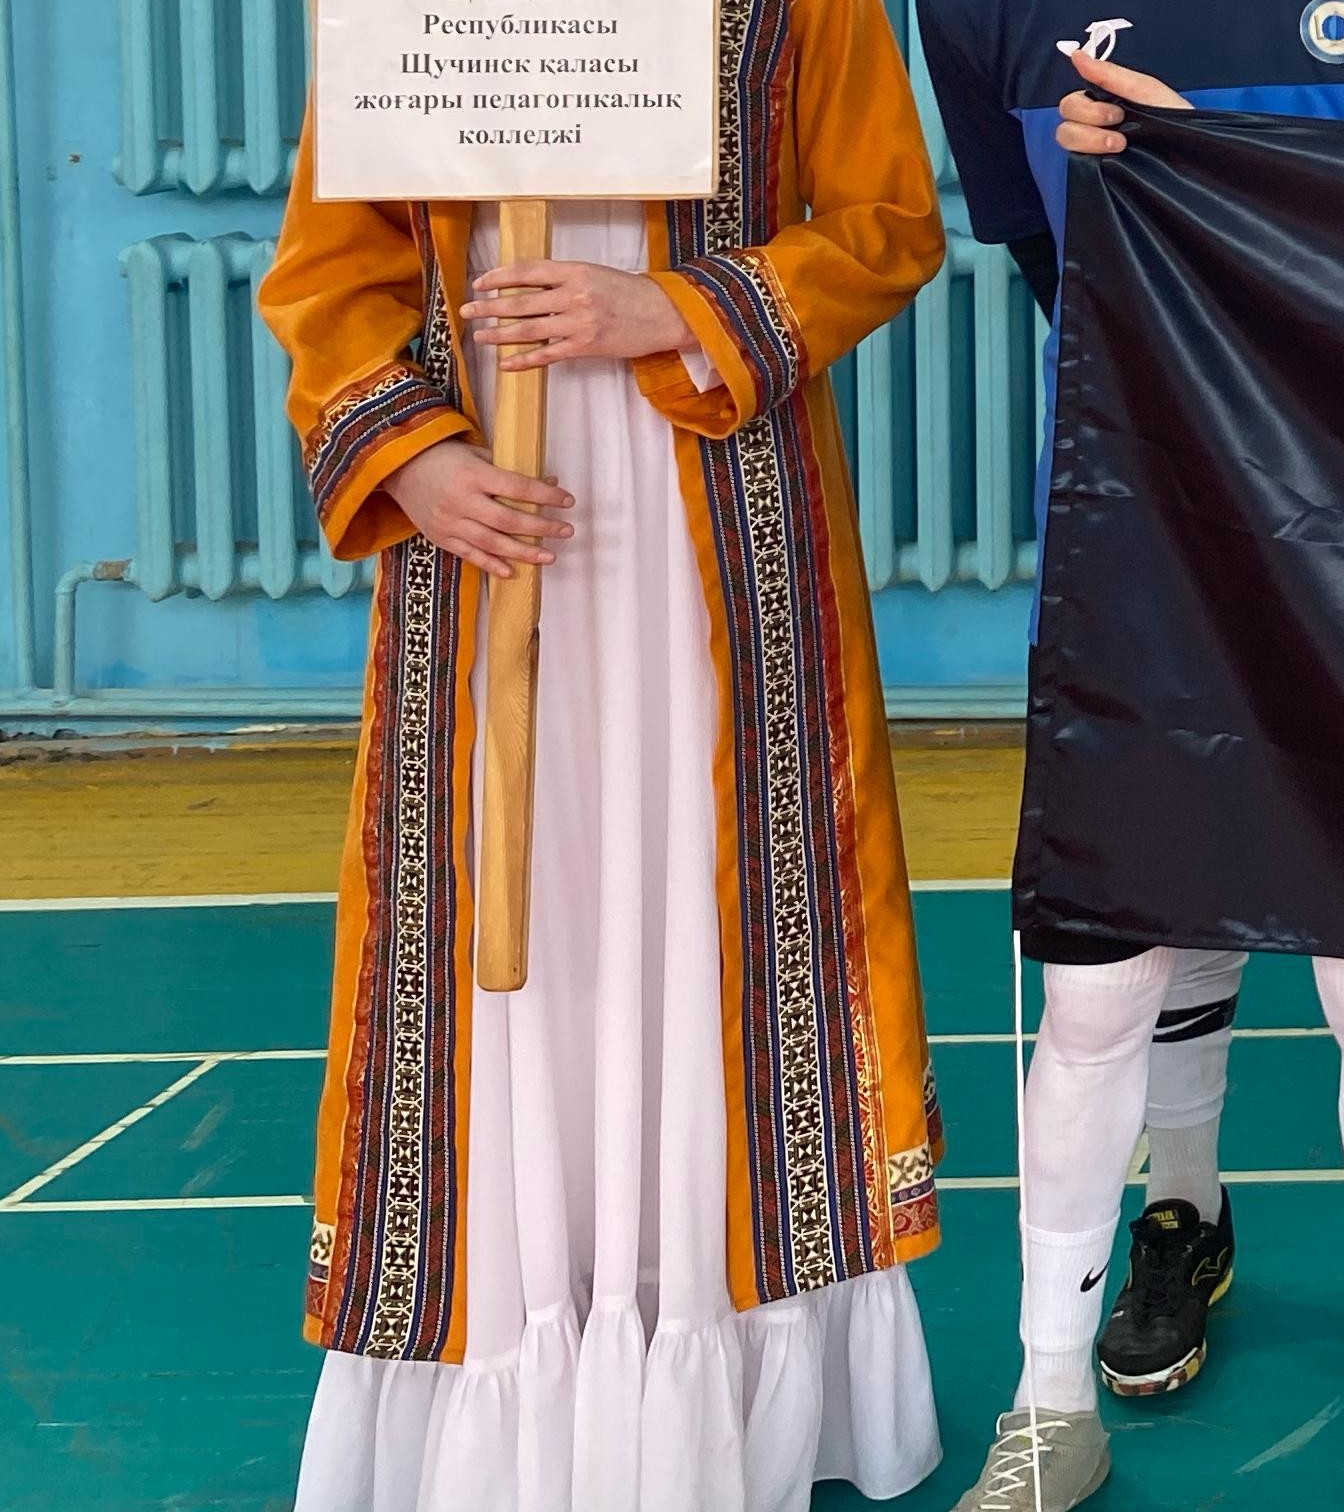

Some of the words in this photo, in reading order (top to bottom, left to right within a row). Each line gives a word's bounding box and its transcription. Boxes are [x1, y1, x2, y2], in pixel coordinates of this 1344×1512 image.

[423, 14, 618, 40] Республикасы
[401, 53, 531, 79] Щучинск
[540, 57, 639, 76] қаласы
[354, 93, 463, 115] жоғары
[473, 90, 682, 113] педагогикалық
[458, 123, 582, 147] колледжі
